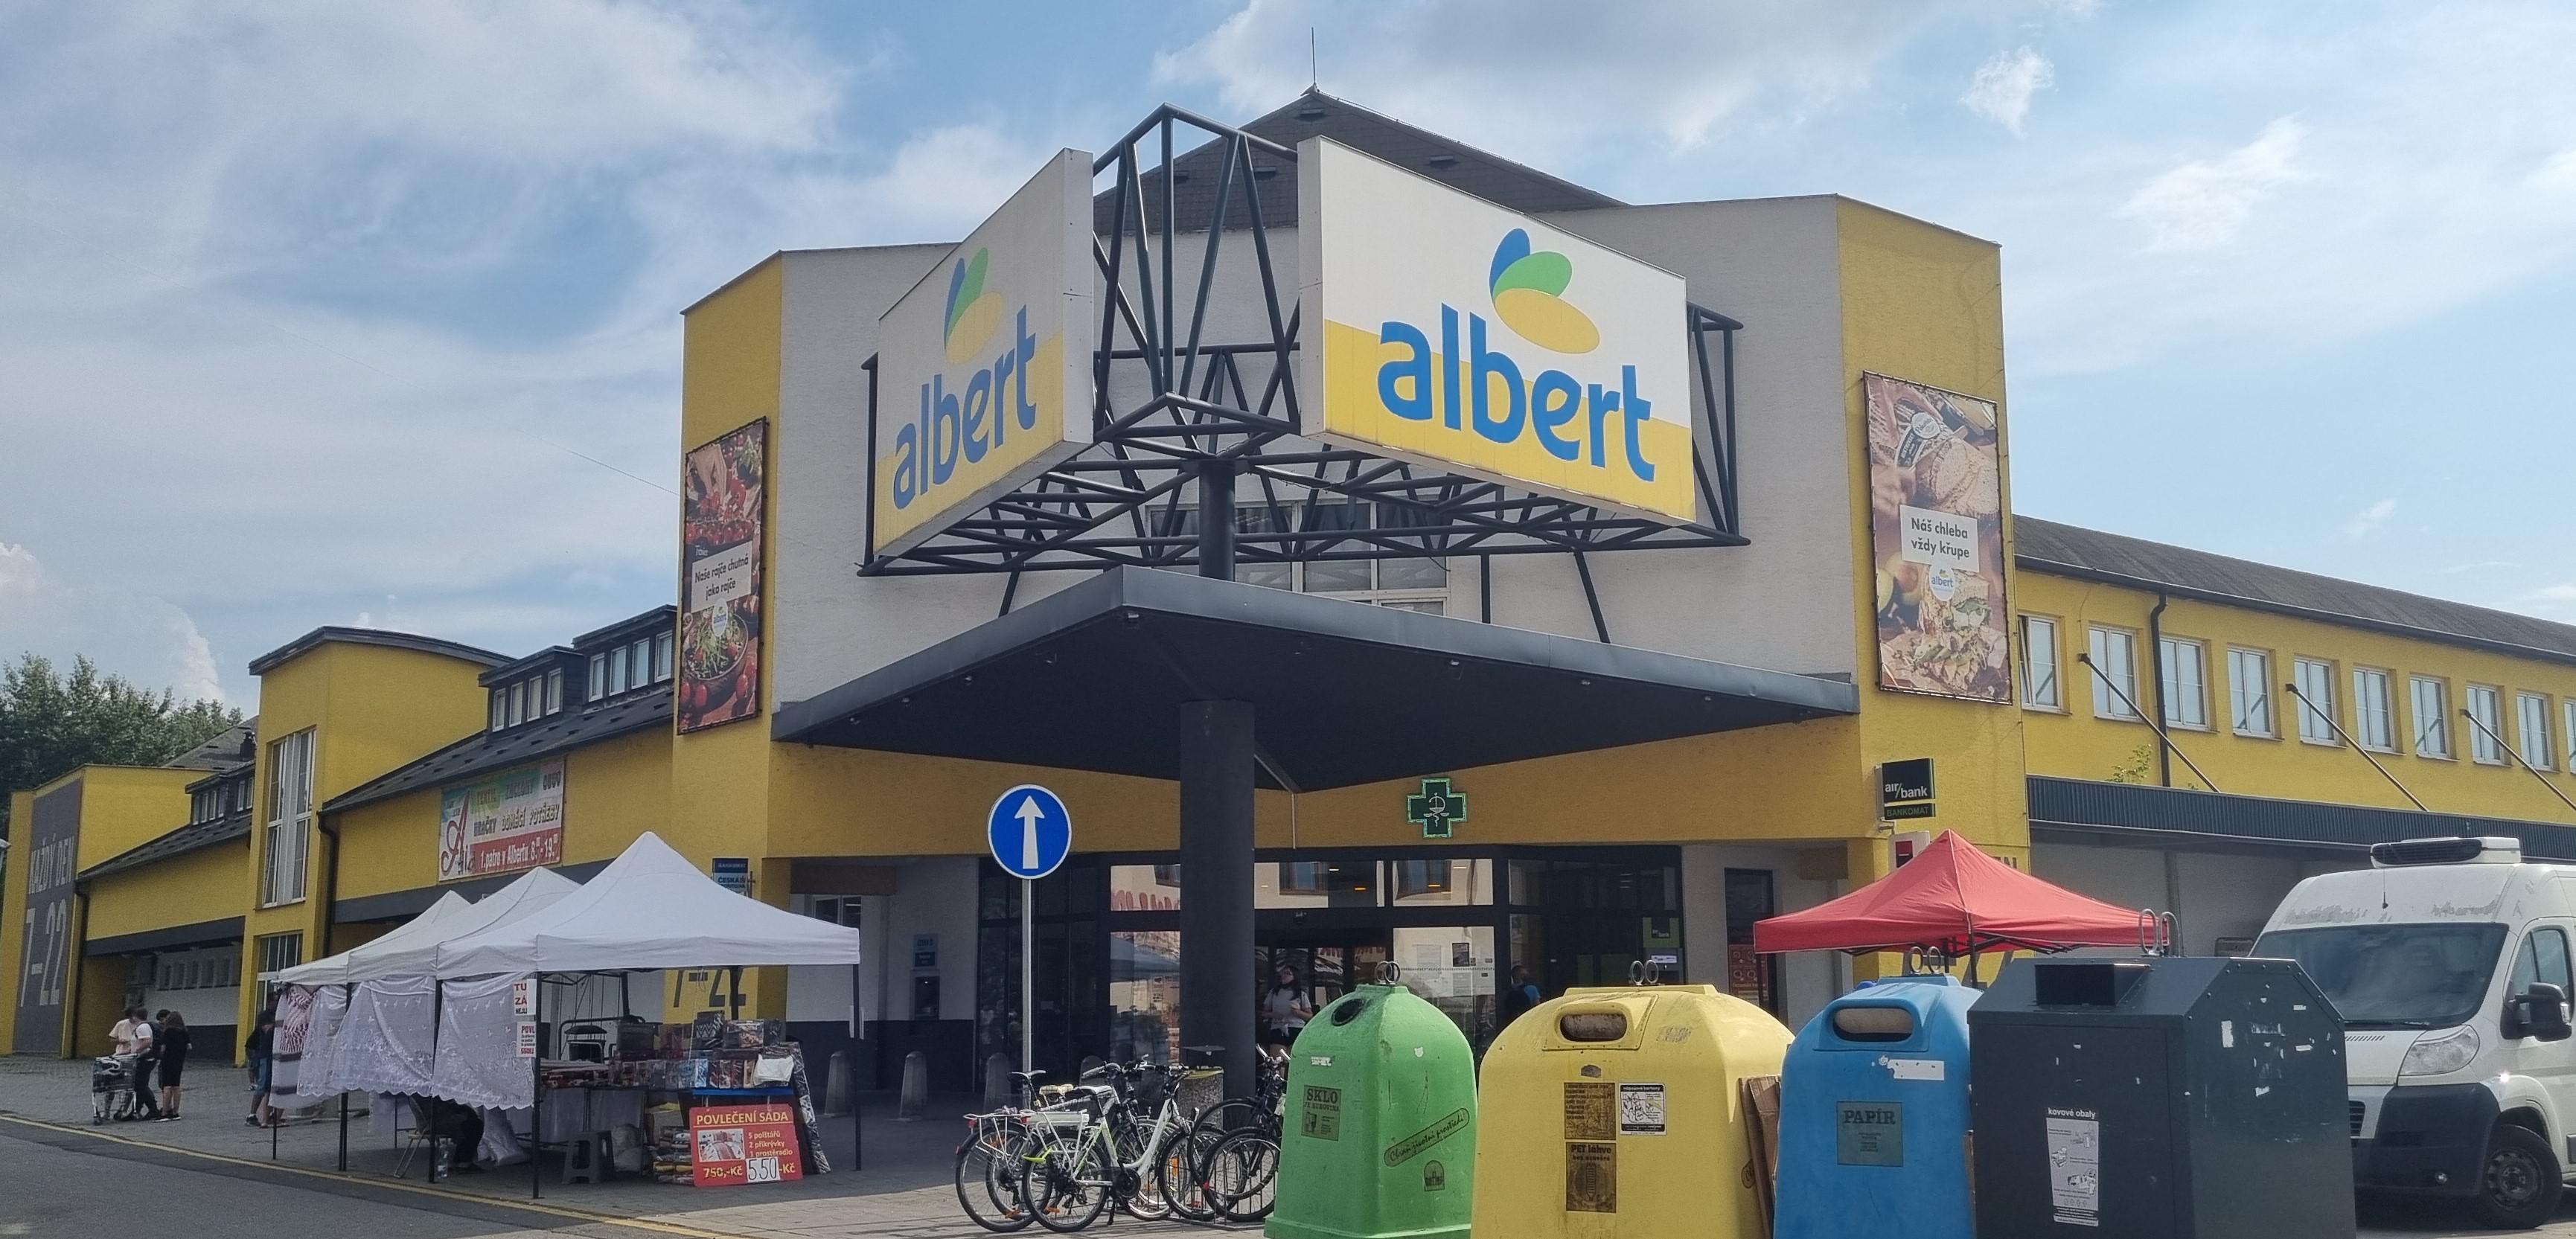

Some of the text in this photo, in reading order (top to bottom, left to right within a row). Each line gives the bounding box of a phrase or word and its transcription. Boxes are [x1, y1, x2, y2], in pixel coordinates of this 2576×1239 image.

[1378, 302, 1655, 482] albert
[893, 304, 1036, 510] albert
[1911, 517, 1968, 539] Náš chleba
[1911, 537, 1969, 560] vždy křupe
[694, 553, 749, 583] Naše rajče chutná
[706, 577, 736, 601] jako rajče
[1931, 576, 1954, 587] albert
[1887, 807, 1928, 817] BANKOMAT
[473, 816, 496, 836] HRAČKY
[56, 836, 74, 887] DEN
[507, 845, 529, 864] Albertu
[21, 899, 66, 1007] 7-22
[1307, 1089, 1337, 1104] SKLO
[697, 1110, 789, 1125] POVLEČENÍ SADA
[1843, 1108, 1896, 1124] PAPÍR
[2048, 1107, 2096, 1119] kovové obaly
[754, 1130, 781, 1140] polštářů
[754, 1141, 785, 1149] přikrývky
[1571, 1144, 1611, 1153] PET láhve
